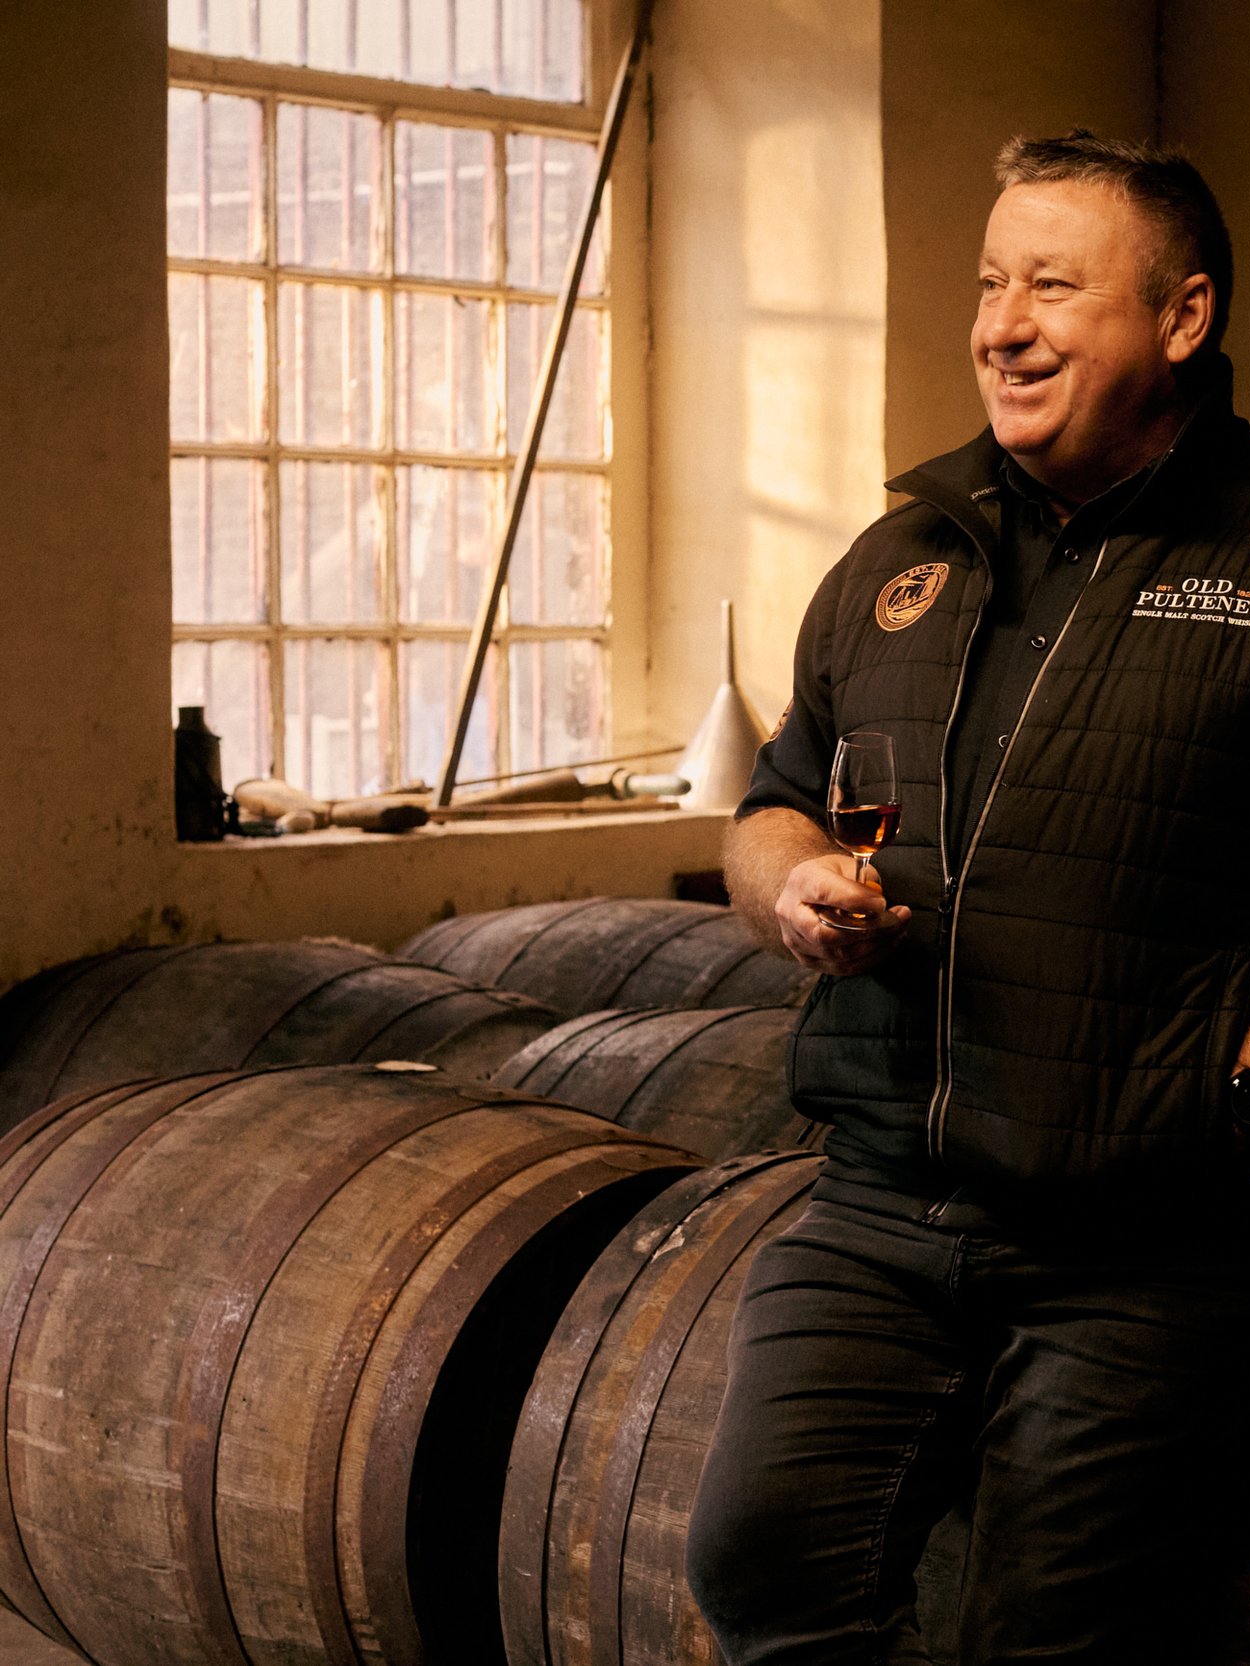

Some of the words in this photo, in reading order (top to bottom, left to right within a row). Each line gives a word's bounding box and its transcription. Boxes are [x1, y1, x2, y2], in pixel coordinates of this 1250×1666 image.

[1182, 578, 1233, 594] OLD
[1132, 610, 1162, 618] SINGLE
[1164, 611, 1188, 619] MALT
[1190, 613, 1225, 622] SCOTCH
